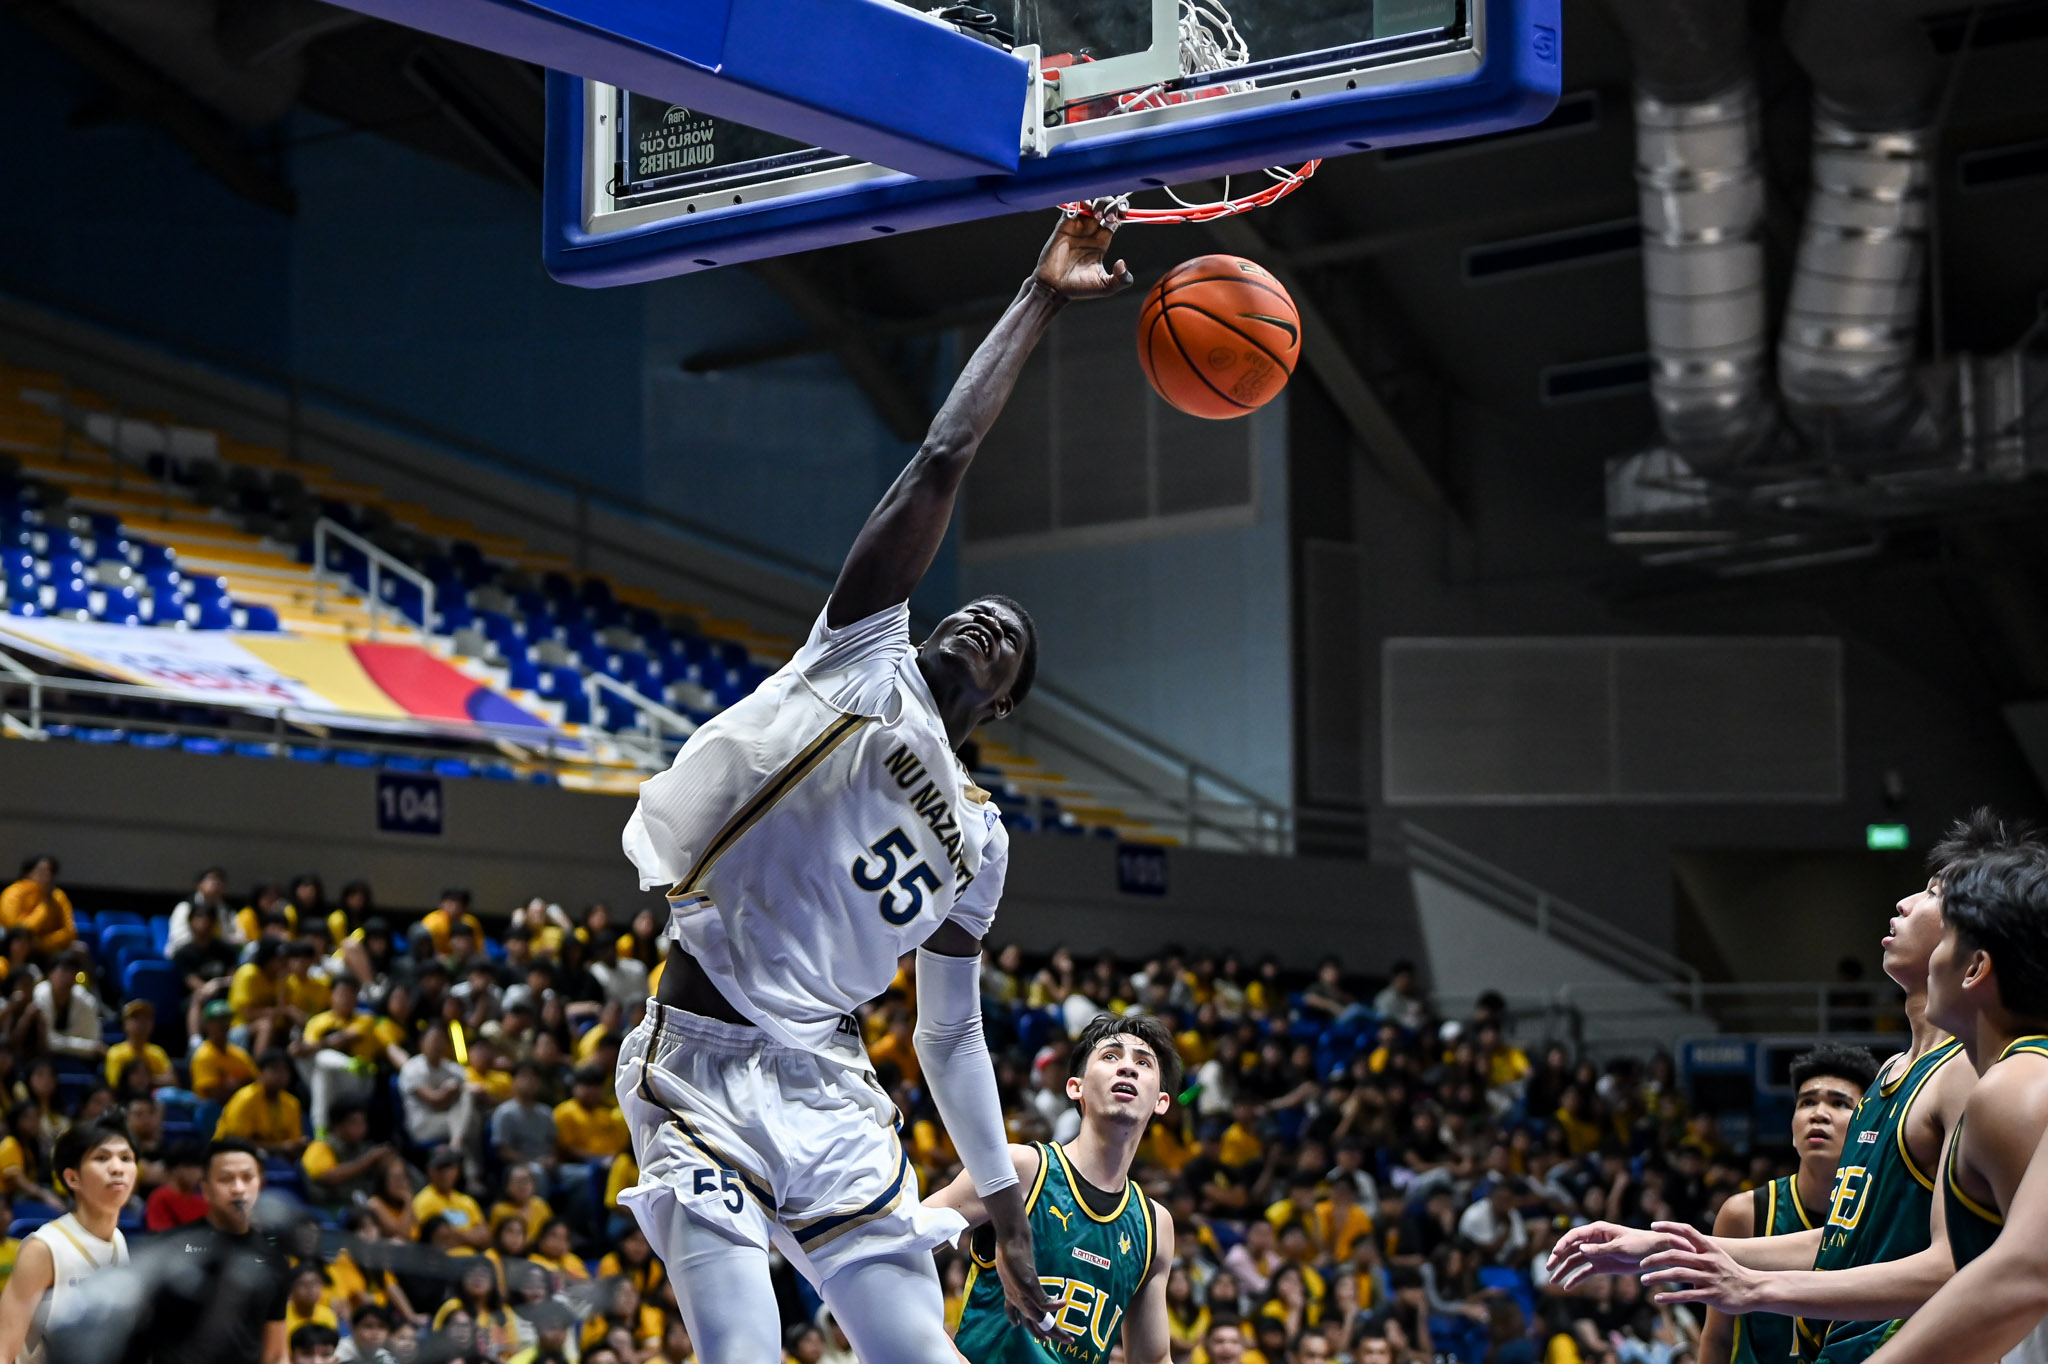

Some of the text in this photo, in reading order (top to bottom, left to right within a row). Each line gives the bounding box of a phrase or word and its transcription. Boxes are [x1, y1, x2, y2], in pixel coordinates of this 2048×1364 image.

[883, 743, 928, 789] NU
[381, 784, 438, 823] 104
[852, 825, 944, 928] 55
[693, 1168, 744, 1214] 55
